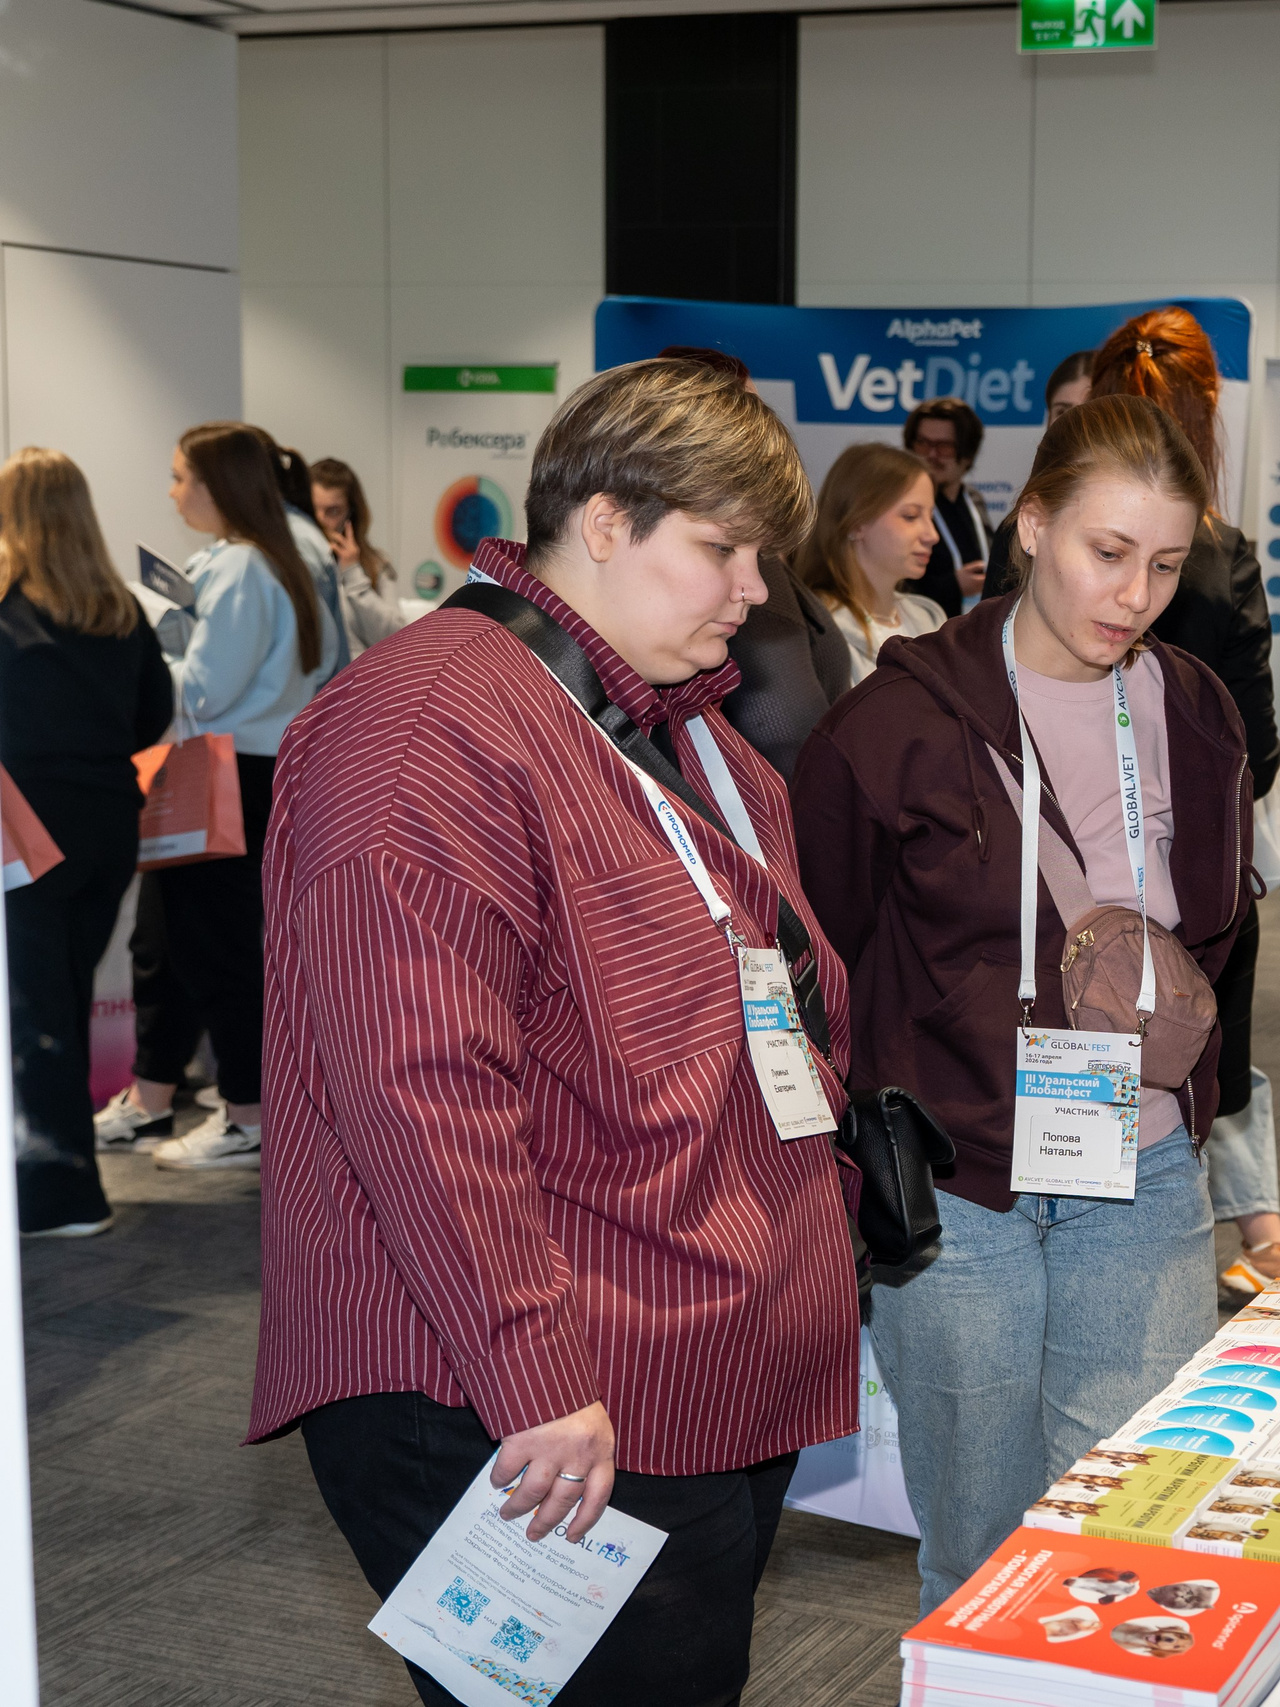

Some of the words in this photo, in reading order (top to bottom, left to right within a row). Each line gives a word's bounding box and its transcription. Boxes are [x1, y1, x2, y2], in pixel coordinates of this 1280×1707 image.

[886, 318, 983, 343] AlphaPet
[817, 352, 1036, 412] VetDiet
[1121, 754, 1139, 839] GLOBAL.VET
[766, 1039, 789, 1048] УЧАСТНИК
[1050, 1041, 1089, 1051] GLOBAL
[1091, 1043, 1111, 1052] FEST
[1025, 1073, 1036, 1084] III
[1038, 1074, 1100, 1089] Уральский
[1025, 1083, 1092, 1099] Глобалфест
[1054, 1107, 1100, 1117] УЧАСТНИК
[1042, 1132, 1081, 1144] Попова
[1039, 1145, 1083, 1158] Наталья
[463, 1536, 491, 1558] закрытия
[491, 1556, 525, 1583] Фестиваля
[472, 1533, 509, 1562] розыгрыше
[508, 1560, 531, 1578] призов
[511, 1540, 533, 1558] печать
[597, 1544, 630, 1567] FEST
[472, 1522, 503, 1548] Опустите
[512, 1555, 531, 1570] карту
[578, 1595, 604, 1610] участия
[545, 1554, 559, 1565] Вас
[559, 1563, 589, 1581] вопроса
[978, 1554, 1028, 1597] ПОМОГАЕМ
[1009, 1549, 1053, 1588] ПОМОГАЯ
[964, 1586, 1020, 1631] ЖИВОТНЫМ
